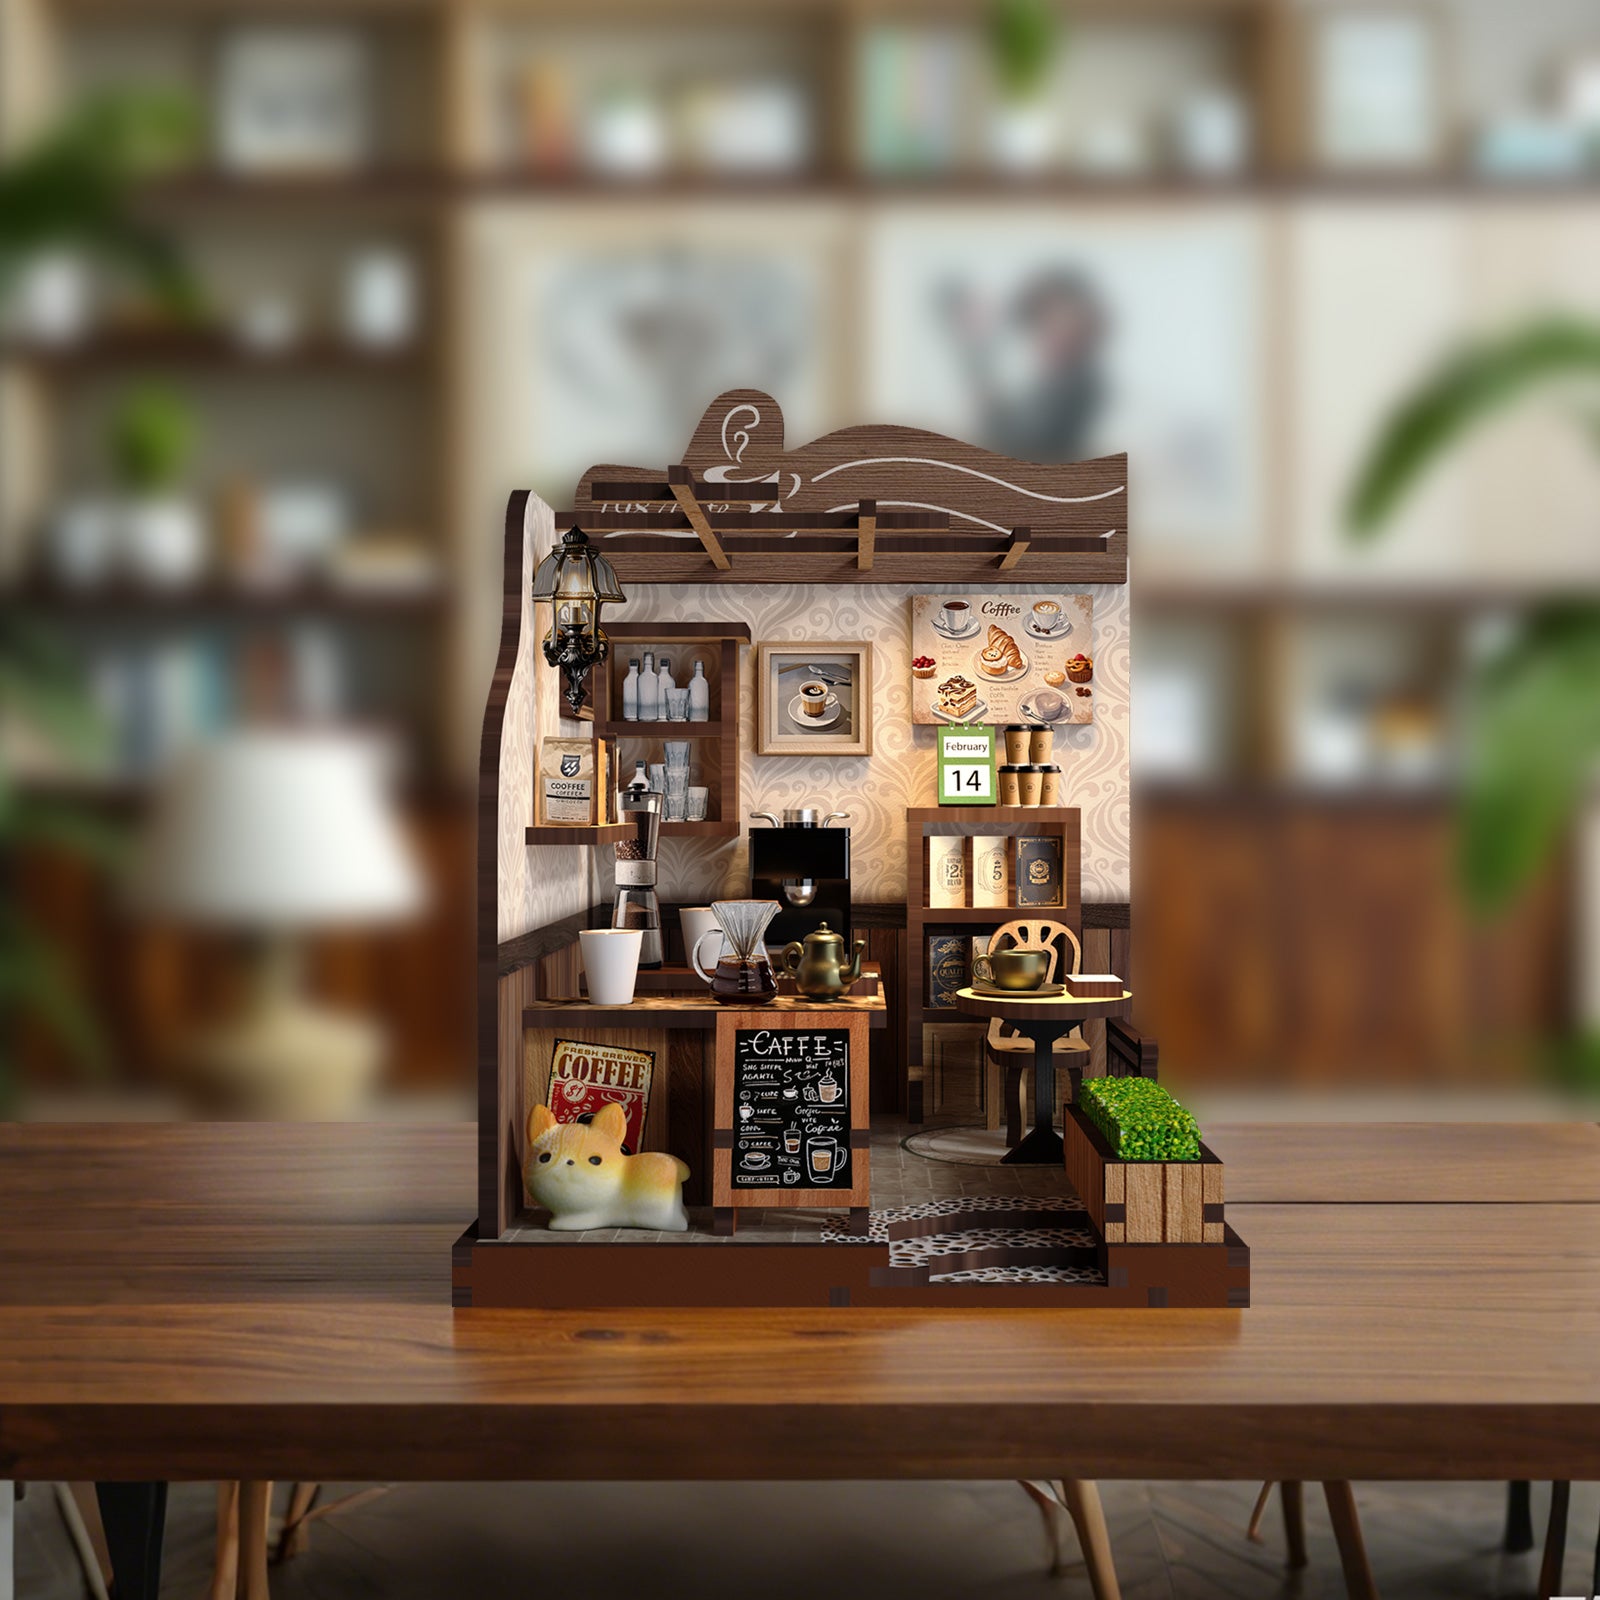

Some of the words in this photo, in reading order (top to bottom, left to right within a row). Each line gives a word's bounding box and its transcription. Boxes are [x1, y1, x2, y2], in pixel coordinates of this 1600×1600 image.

[981, 601, 1021, 616] Cofffee
[945, 742, 988, 752] February
[952, 769, 982, 791] 14
[992, 865, 1003, 880] 5
[748, 1031, 832, 1056] CAFFE
[563, 1046, 599, 1057] FRESH
[602, 1051, 647, 1063] BREWED
[558, 1054, 646, 1089] COFFEE
[566, 1084, 584, 1097] $1
